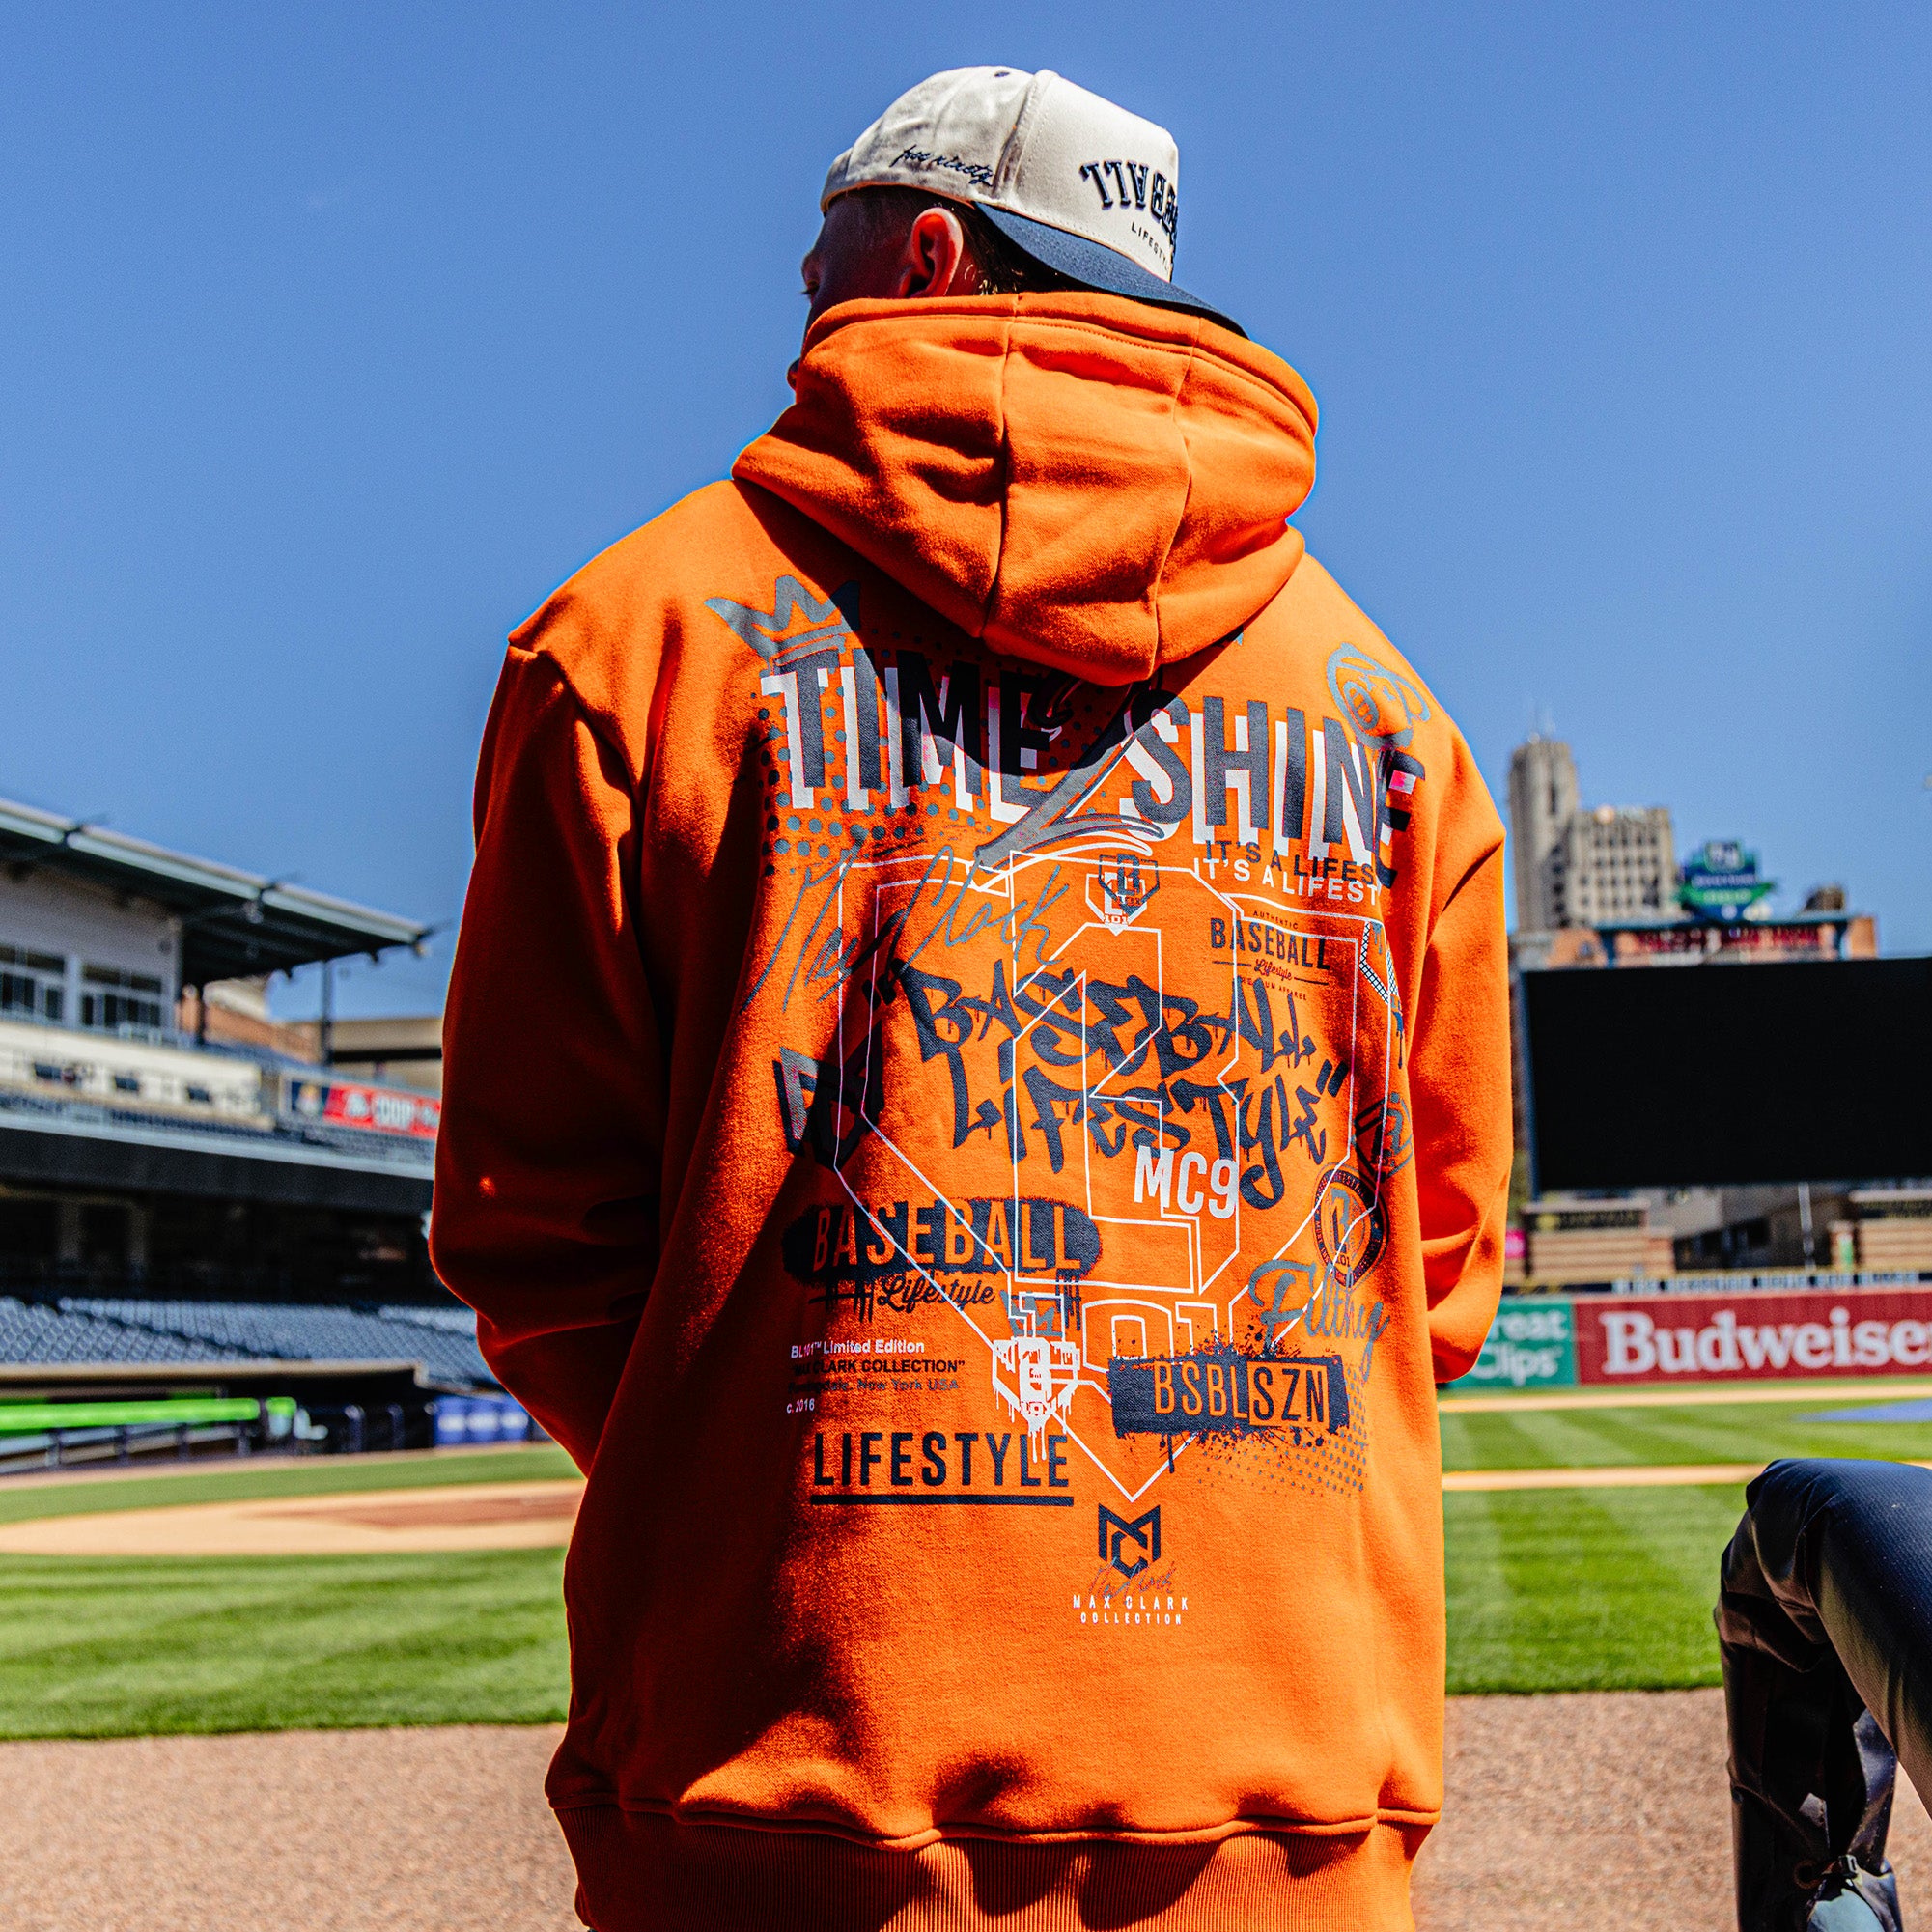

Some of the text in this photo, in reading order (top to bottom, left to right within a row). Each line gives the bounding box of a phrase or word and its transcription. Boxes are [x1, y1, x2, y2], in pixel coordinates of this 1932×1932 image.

[1131, 221, 1171, 272] LIFESTYL
[761, 646, 1051, 824] TIME
[1193, 857, 1380, 906] IT'S A LIFEST
[1206, 839, 1374, 885] IT'S A LIFES
[1253, 910, 1299, 930] AUTHENTIC
[1210, 917, 1330, 970] BASEBALL
[1254, 958, 1292, 982] Lifestyle
[1133, 1144, 1237, 1219] MC9
[813, 1199, 1081, 1274] BASEBALL
[877, 1273, 995, 1313] Lifestyle
[823, 1340, 871, 1355] Limited
[874, 1339, 925, 1354] Edition
[1487, 1309, 1570, 1342] reat
[1599, 1305, 1932, 1375] Budweise
[813, 1359, 856, 1374] CLARK
[856, 1378, 887, 1391] New
[891, 1378, 923, 1391] York
[928, 1379, 959, 1391] USA
[814, 1431, 1070, 1488] LIFESTYLE
[1072, 1594, 1189, 1610] MAX CLARK
[1080, 1611, 1182, 1625] COLLECTION
